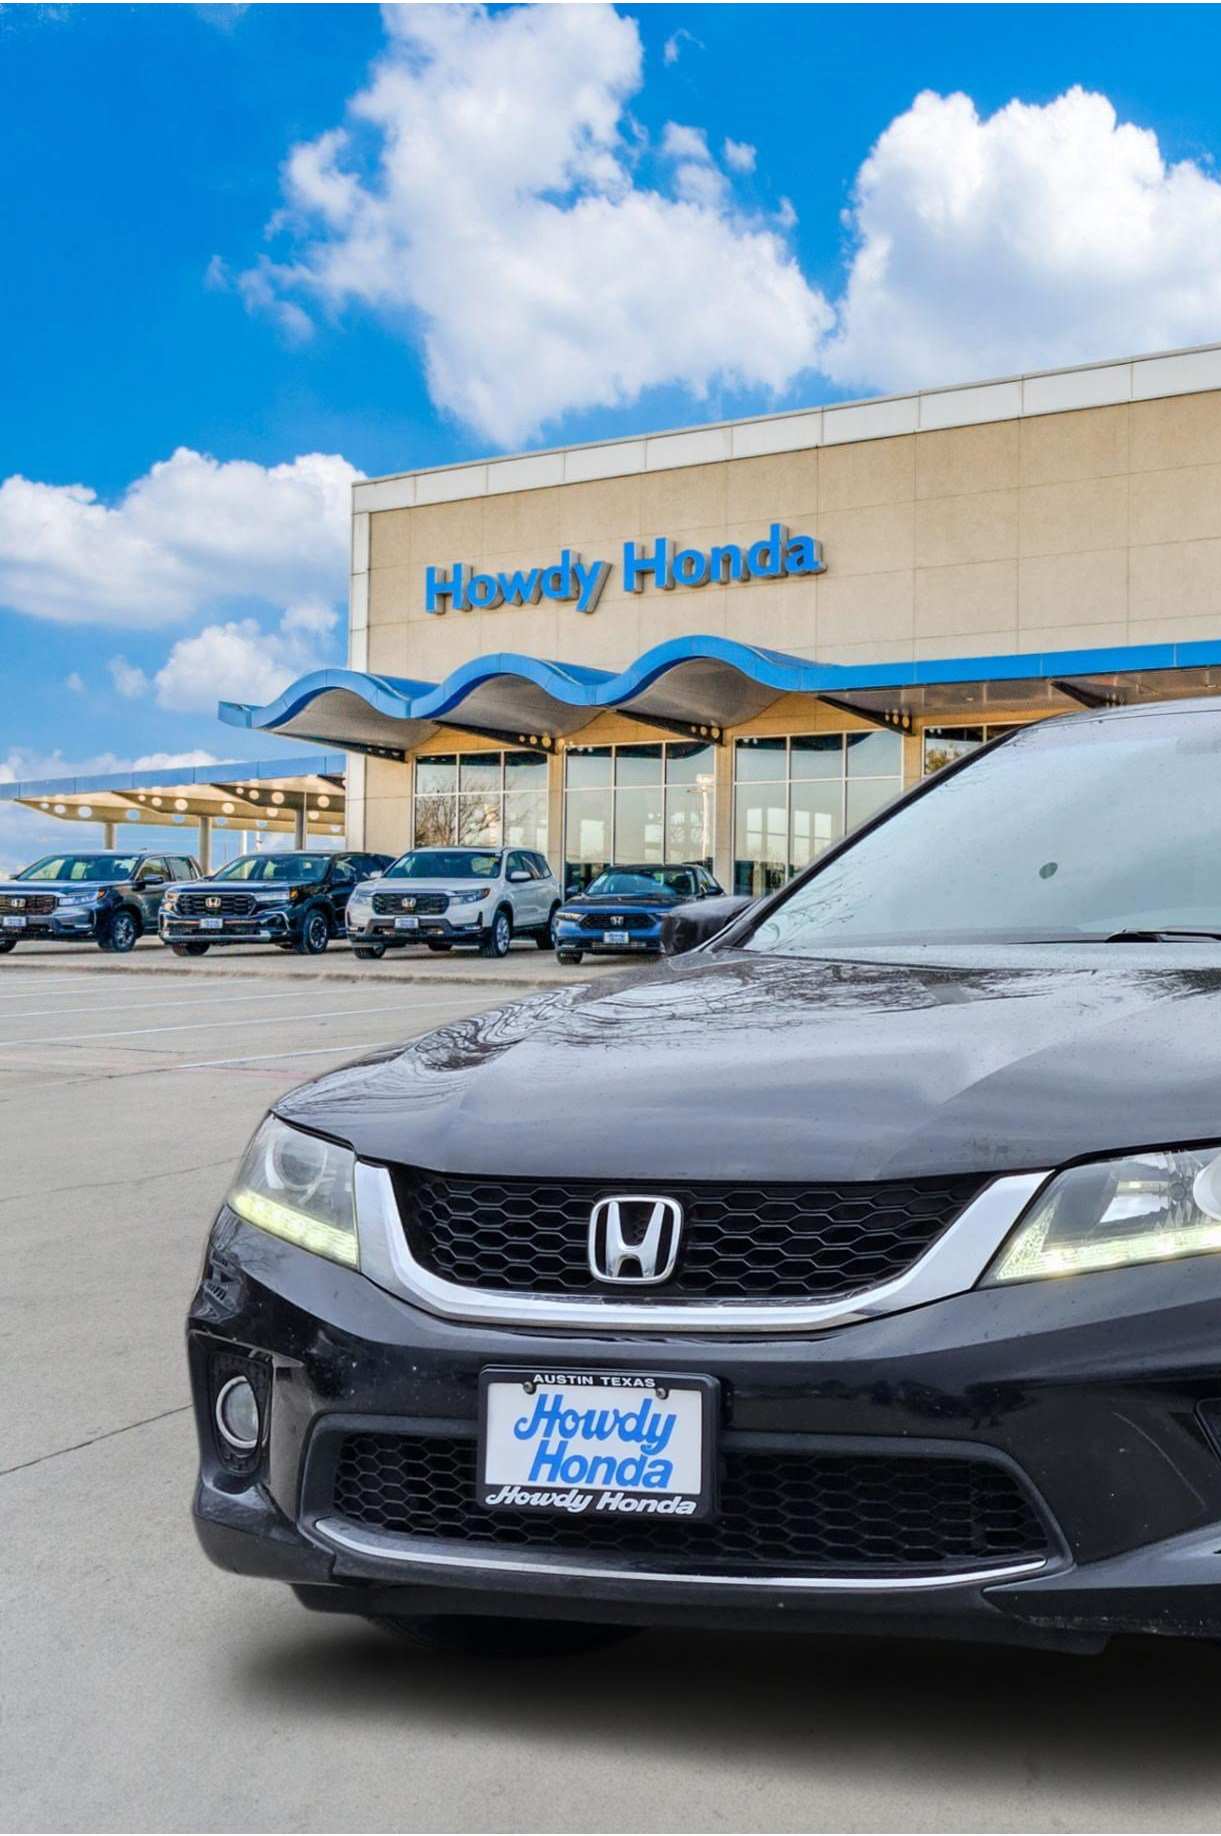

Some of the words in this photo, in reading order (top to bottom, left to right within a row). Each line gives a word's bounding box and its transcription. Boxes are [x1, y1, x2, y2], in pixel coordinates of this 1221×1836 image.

[425, 548, 612, 614] Howdy
[623, 522, 826, 593] Honda
[533, 1373, 594, 1386] AUSTIN
[600, 1376, 656, 1388] TEXAS
[513, 1393, 677, 1456] Howdy
[528, 1439, 673, 1489] Honda
[485, 1485, 593, 1513] Howdy
[596, 1491, 697, 1515] Honda
